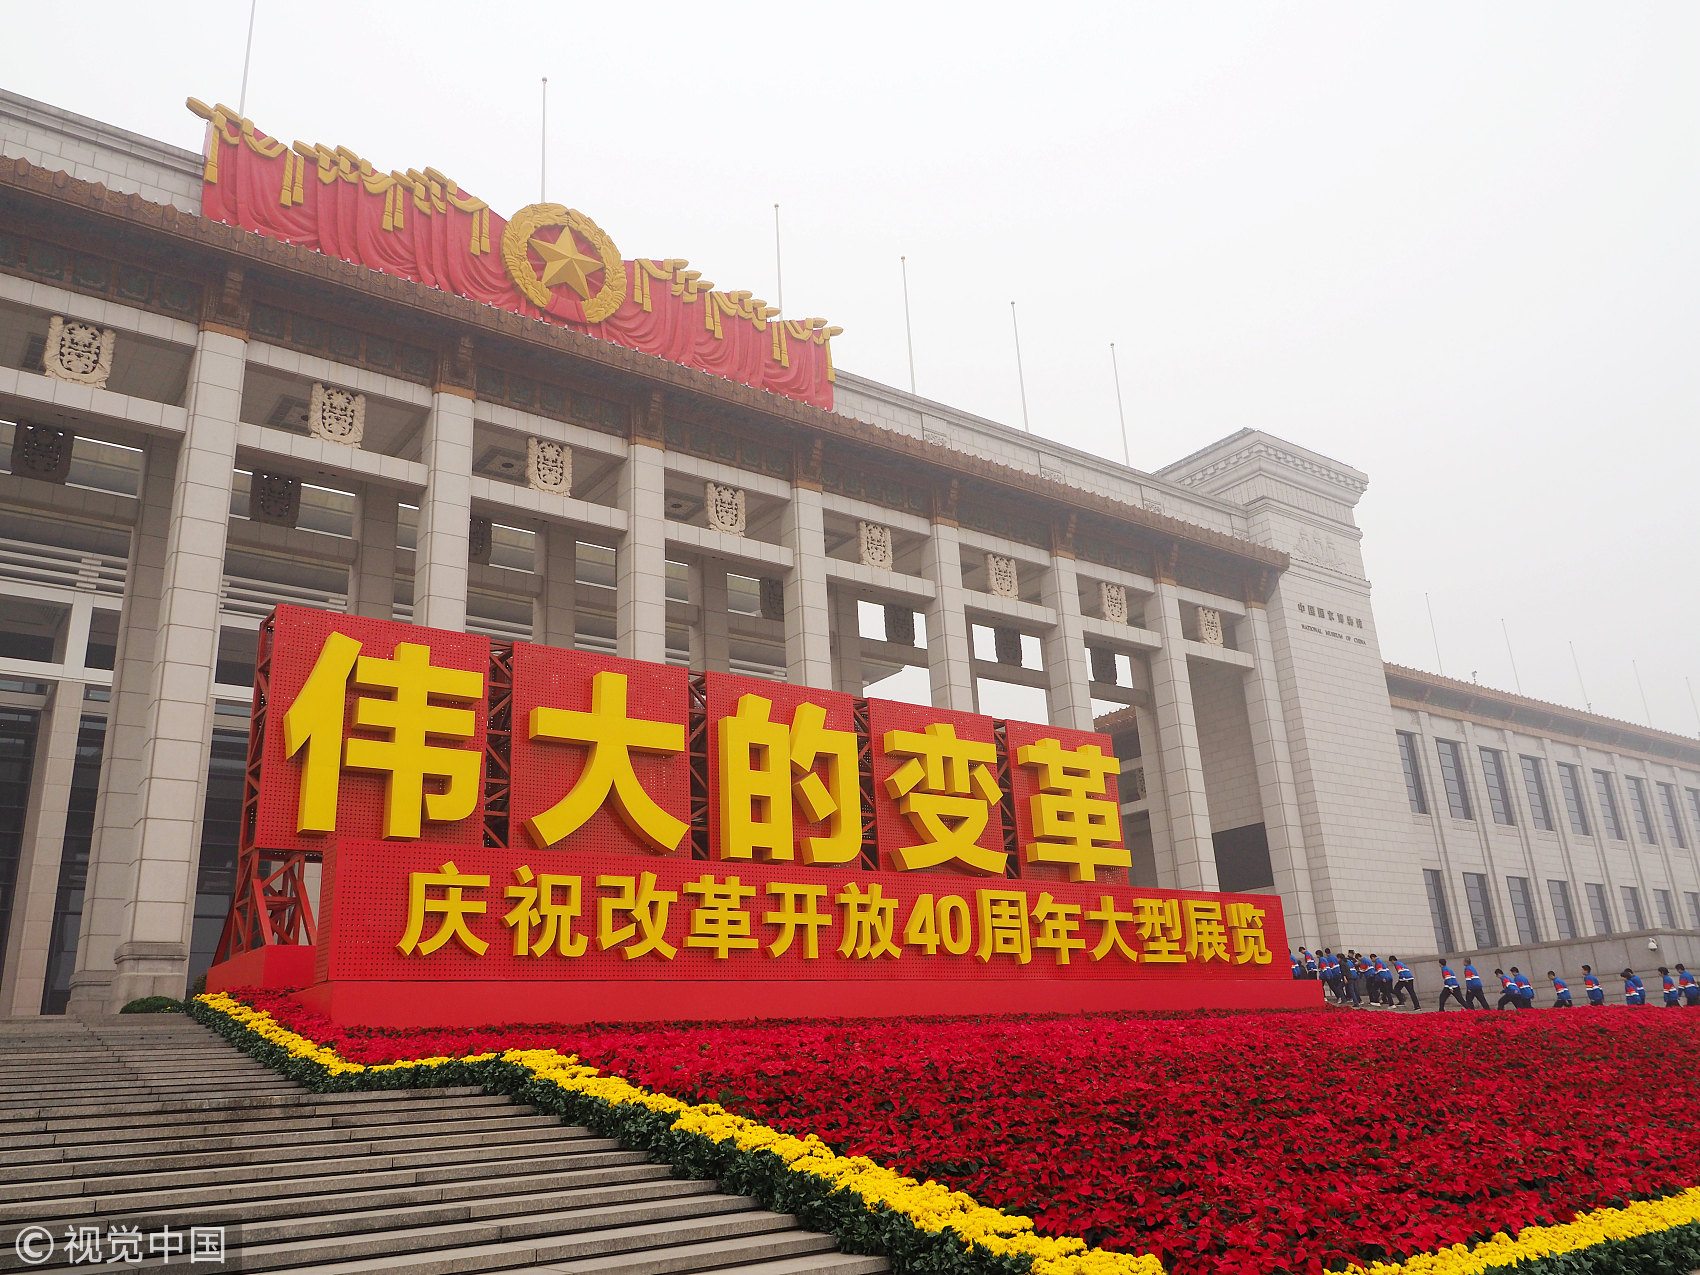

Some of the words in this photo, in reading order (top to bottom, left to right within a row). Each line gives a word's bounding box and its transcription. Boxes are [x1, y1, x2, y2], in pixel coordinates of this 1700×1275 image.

[1301, 624, 1323, 634] NATIONAL
[1325, 630, 1343, 639] MUSEUM
[282, 631, 1132, 882] 伟大的变革
[396, 861, 1273, 965] 庆祝改革开放40周年大型展览
